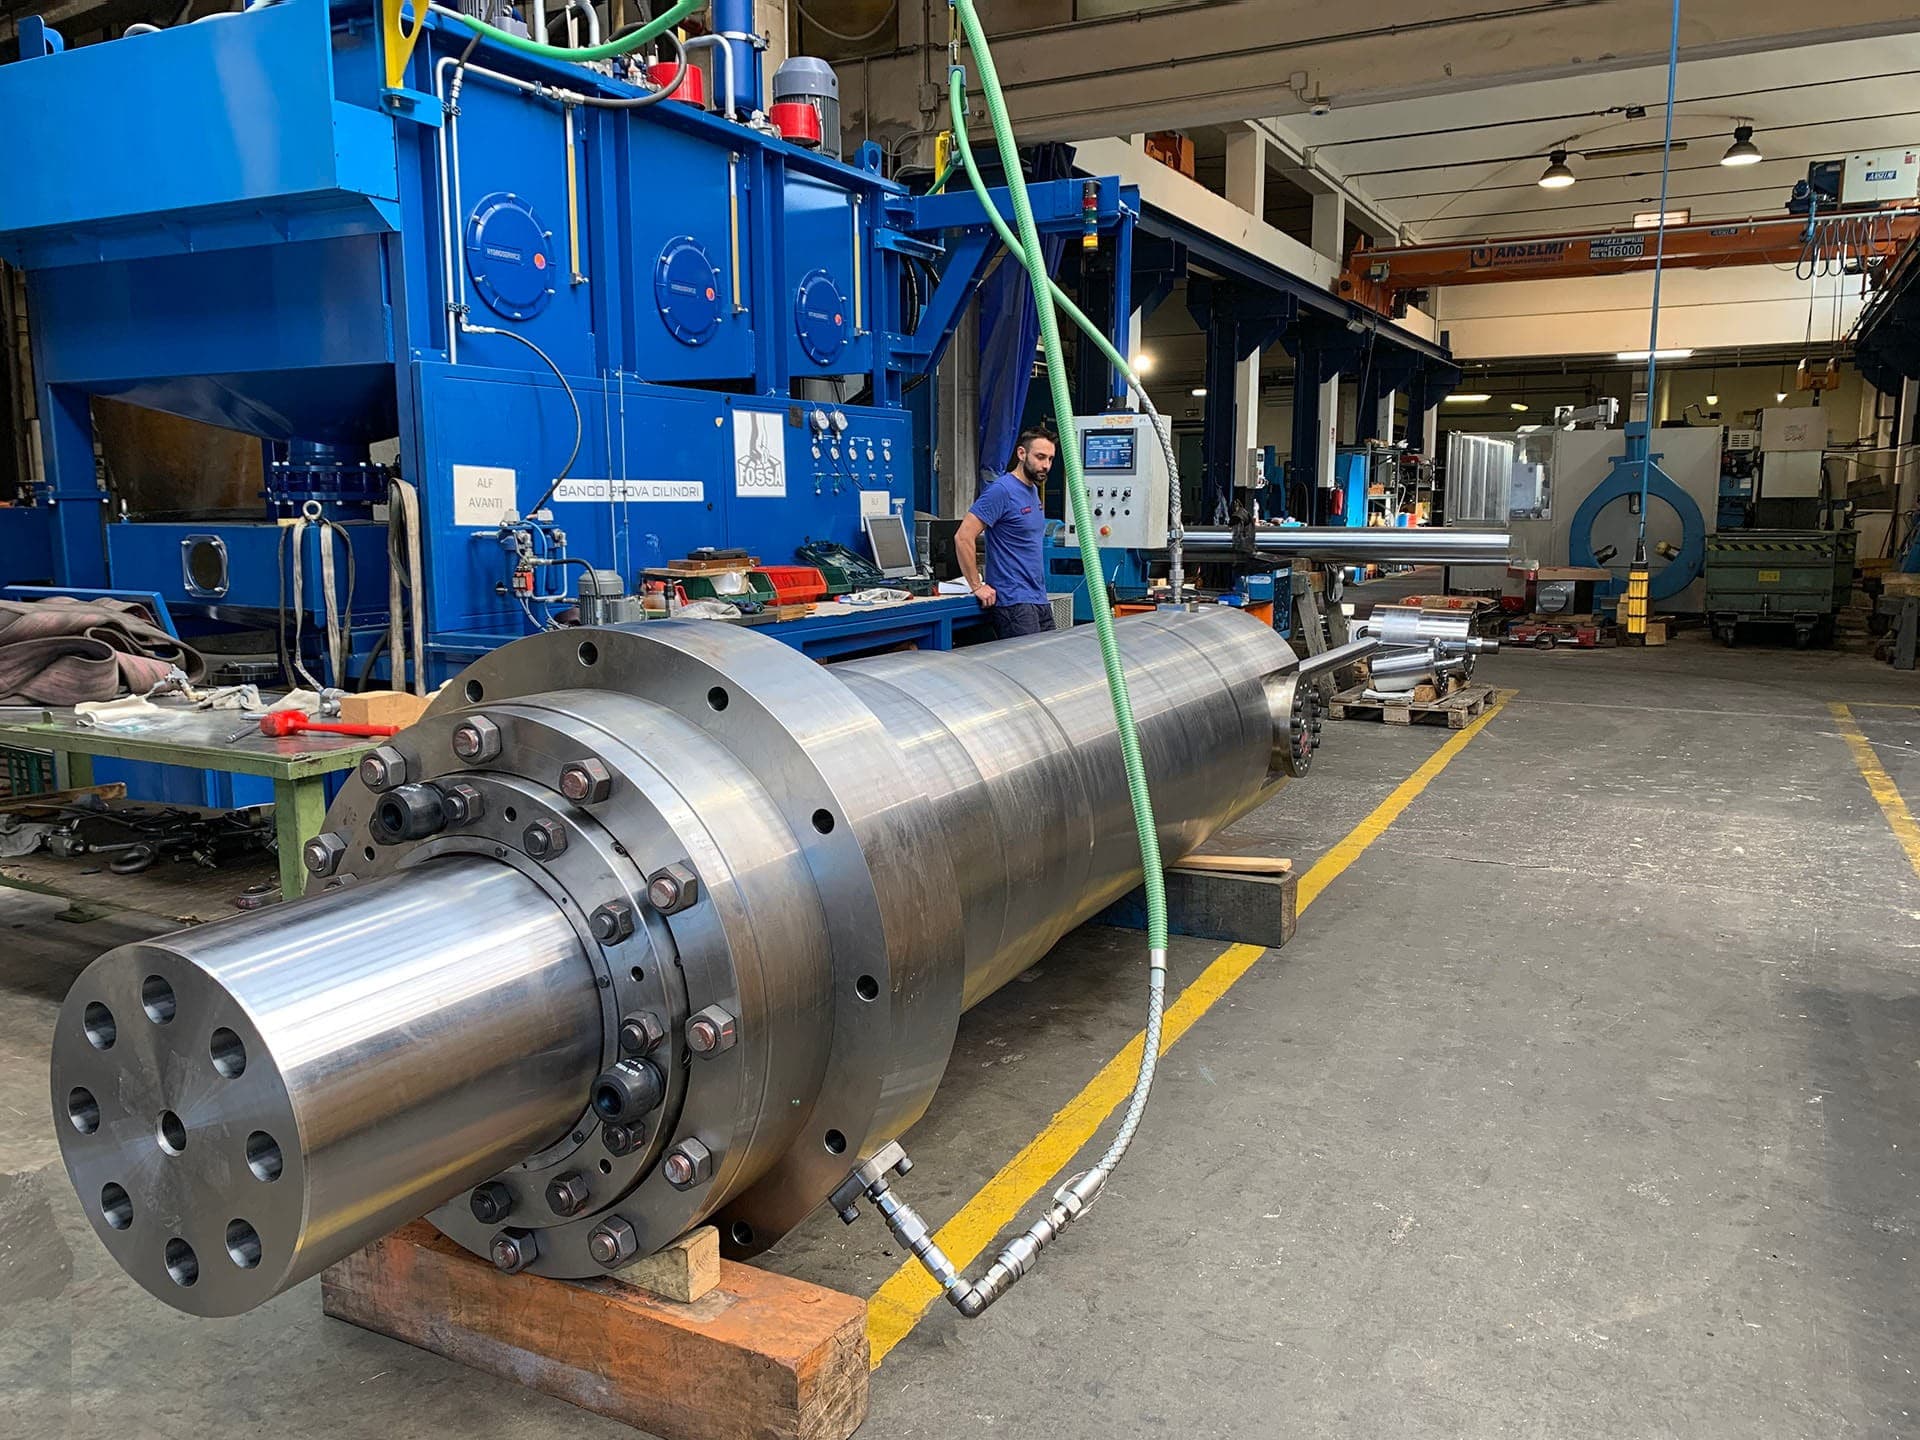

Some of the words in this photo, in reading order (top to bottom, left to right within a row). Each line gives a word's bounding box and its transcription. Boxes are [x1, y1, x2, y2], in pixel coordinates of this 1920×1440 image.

[1495, 241, 1565, 258] ANSELMI
[1610, 245, 1642, 256] 16000
[738, 463, 784, 487] FOSSA
[476, 477, 495, 489] ALF
[559, 485, 605, 497] BANCO
[610, 486, 653, 497] PROVA
[652, 486, 700, 497] CILINDRI
[468, 497, 503, 509] AVANTI
